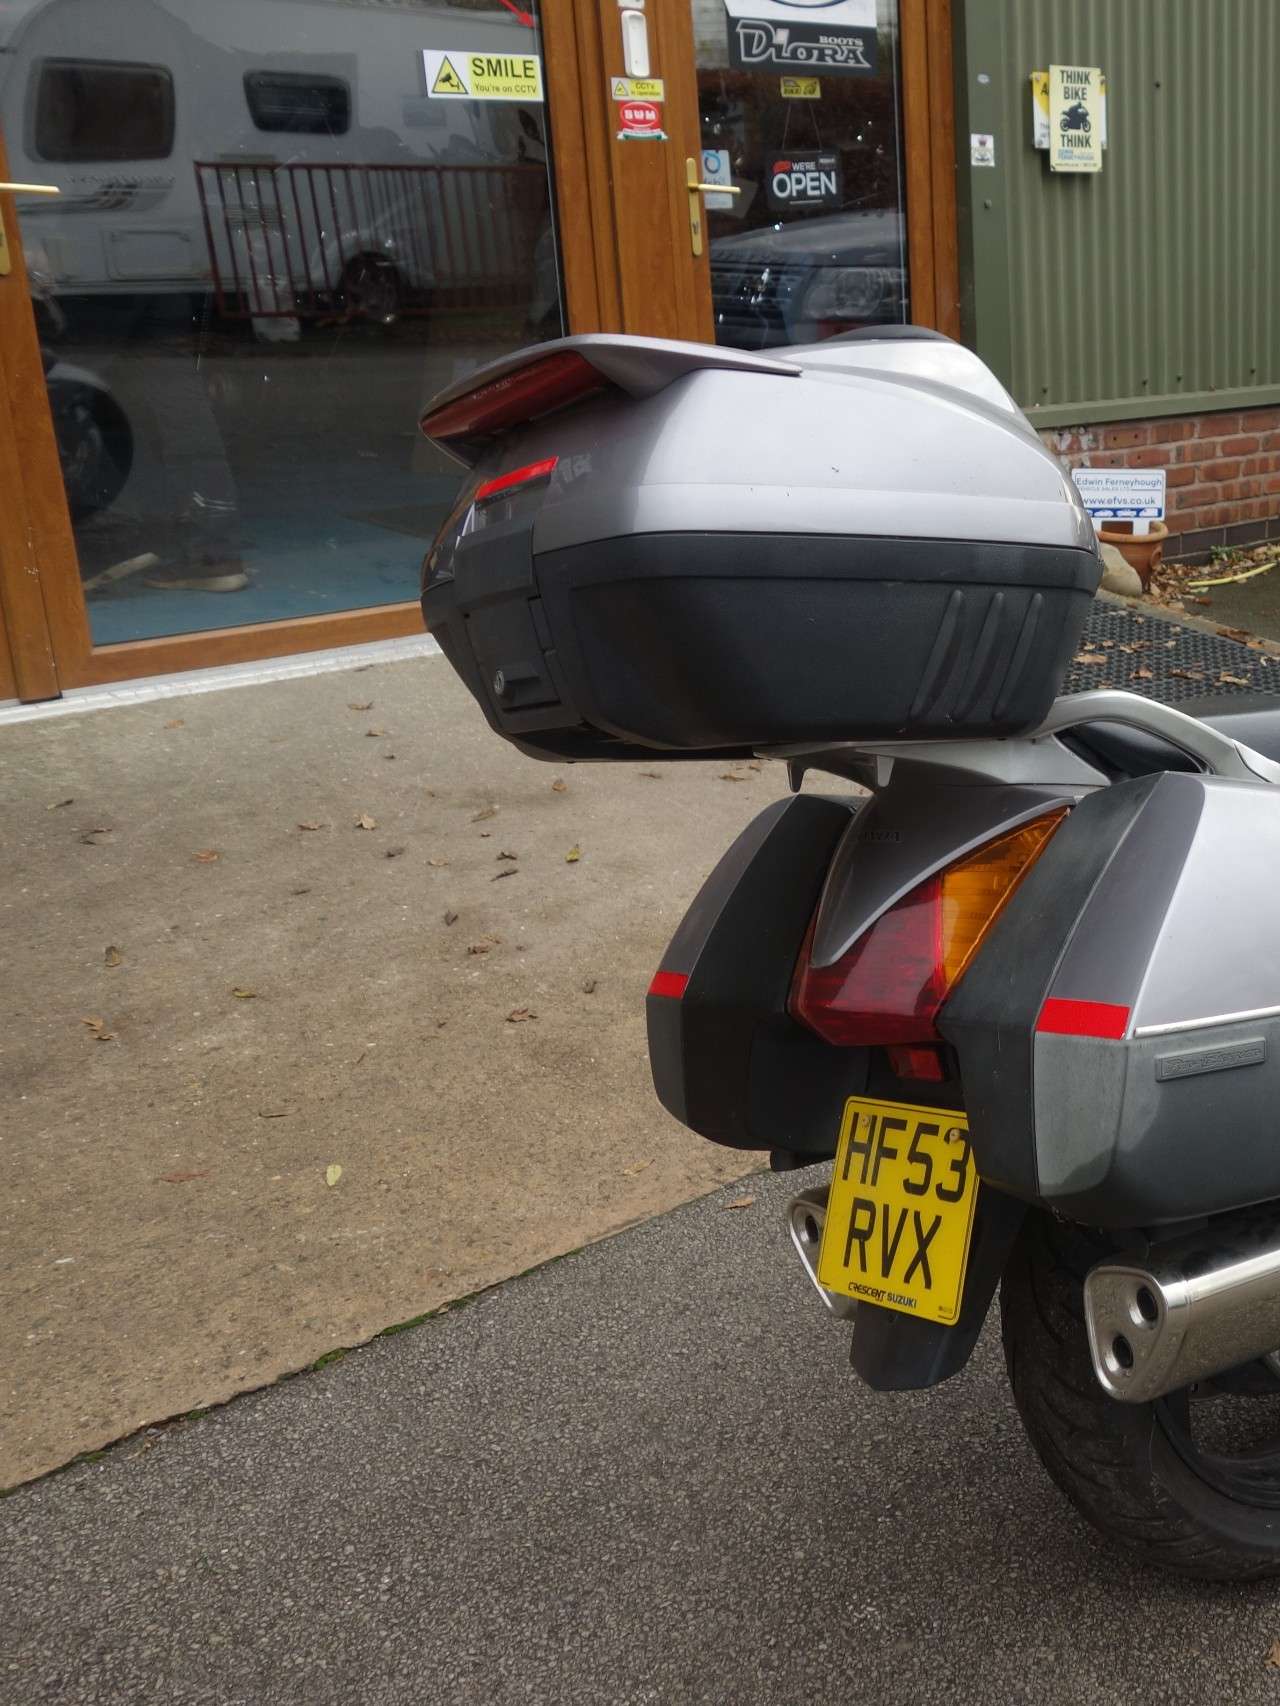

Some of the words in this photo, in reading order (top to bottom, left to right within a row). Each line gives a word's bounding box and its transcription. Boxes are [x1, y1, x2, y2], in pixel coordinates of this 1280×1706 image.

[819, 35, 864, 46] BOOTS
[472, 58, 535, 78] SMILE
[1060, 69, 1091, 85] THINK
[475, 82, 501, 92] You're
[514, 85, 537, 93] CCTV
[1064, 86, 1087, 100] BIKE
[1061, 134, 1091, 148] THINK
[773, 171, 836, 198] OPEN
[1077, 477, 1102, 486] Edwin
[1105, 477, 1162, 488] Ferneyhough
[842, 1112, 971, 1203] HF53
[843, 1197, 942, 1290] RVX
[848, 1282, 886, 1301] CRESCENT
[886, 1291, 918, 1309] SUZUKI
